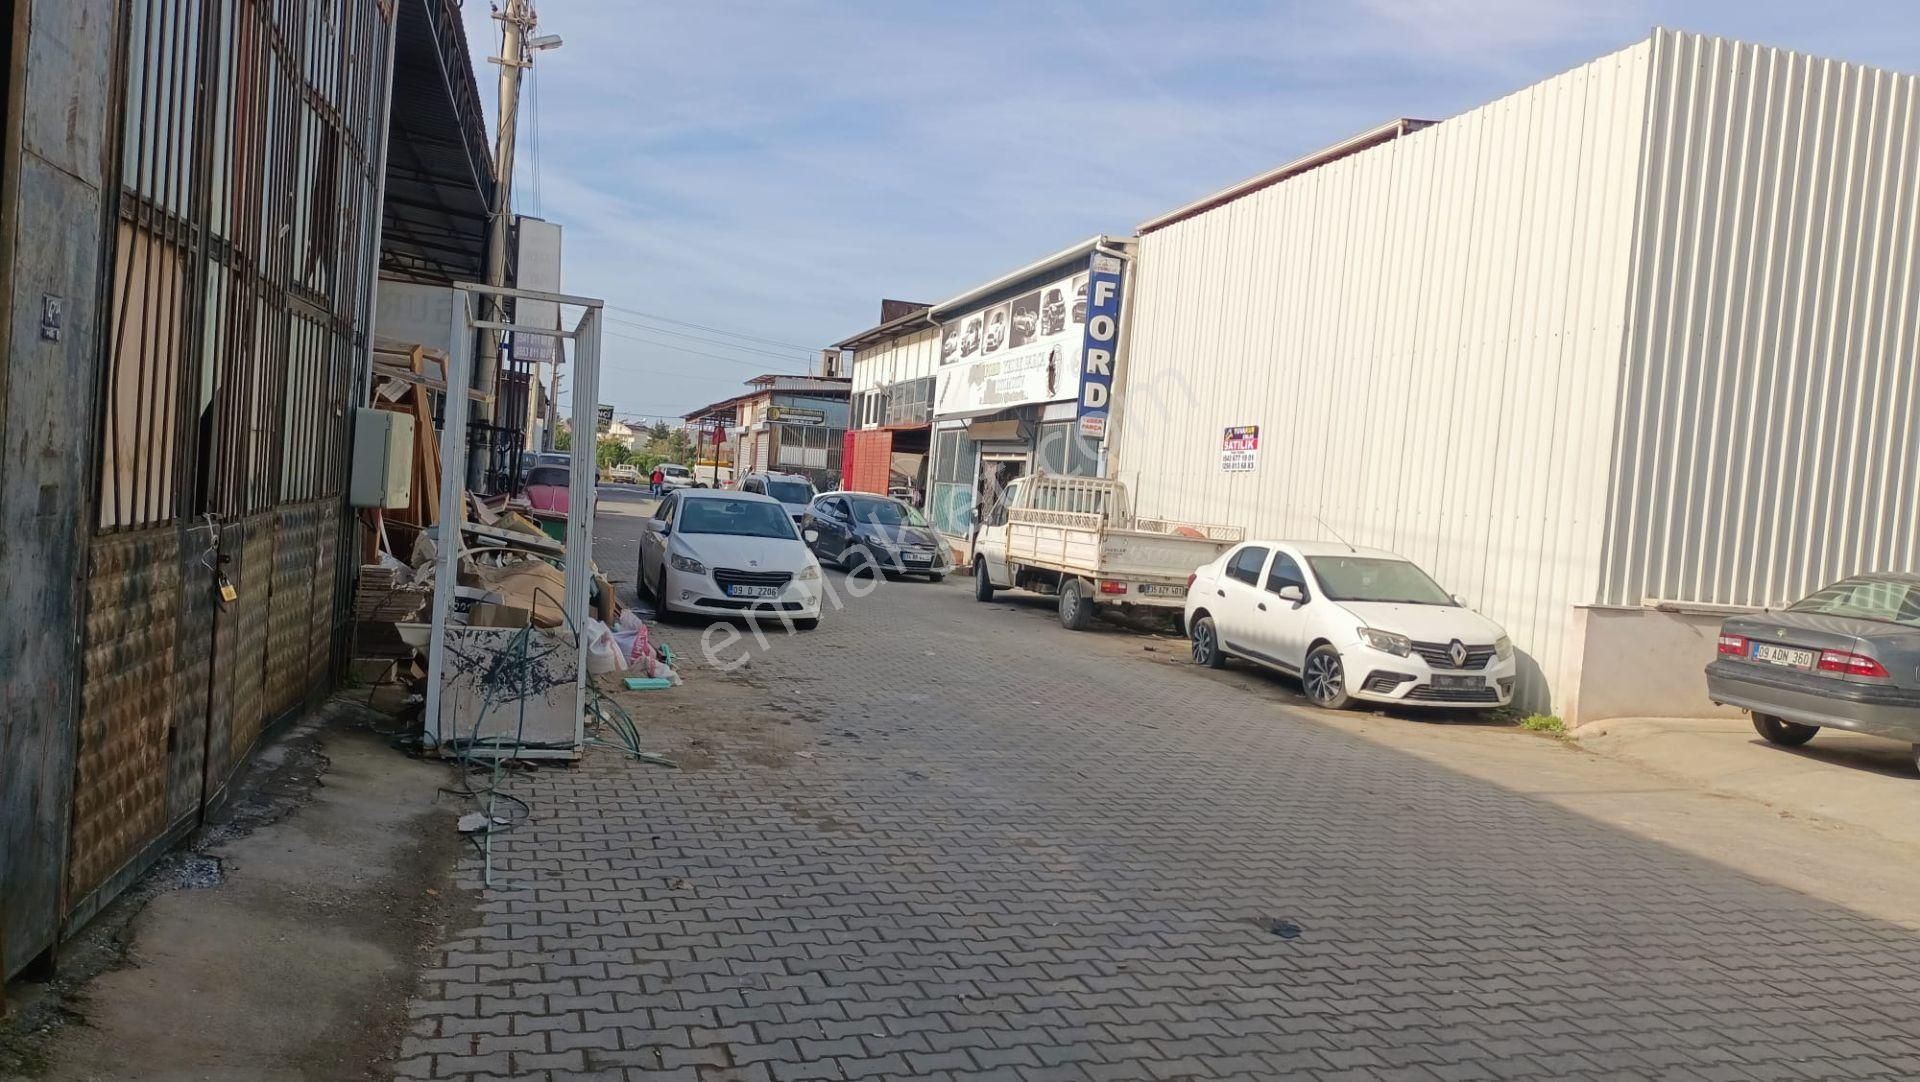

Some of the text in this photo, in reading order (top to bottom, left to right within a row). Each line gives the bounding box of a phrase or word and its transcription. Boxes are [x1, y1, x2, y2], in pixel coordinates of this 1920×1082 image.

[1084, 281, 1115, 408] FORD
[733, 586, 743, 594] 09
[1759, 646, 1809, 665] 09 ADN 360
